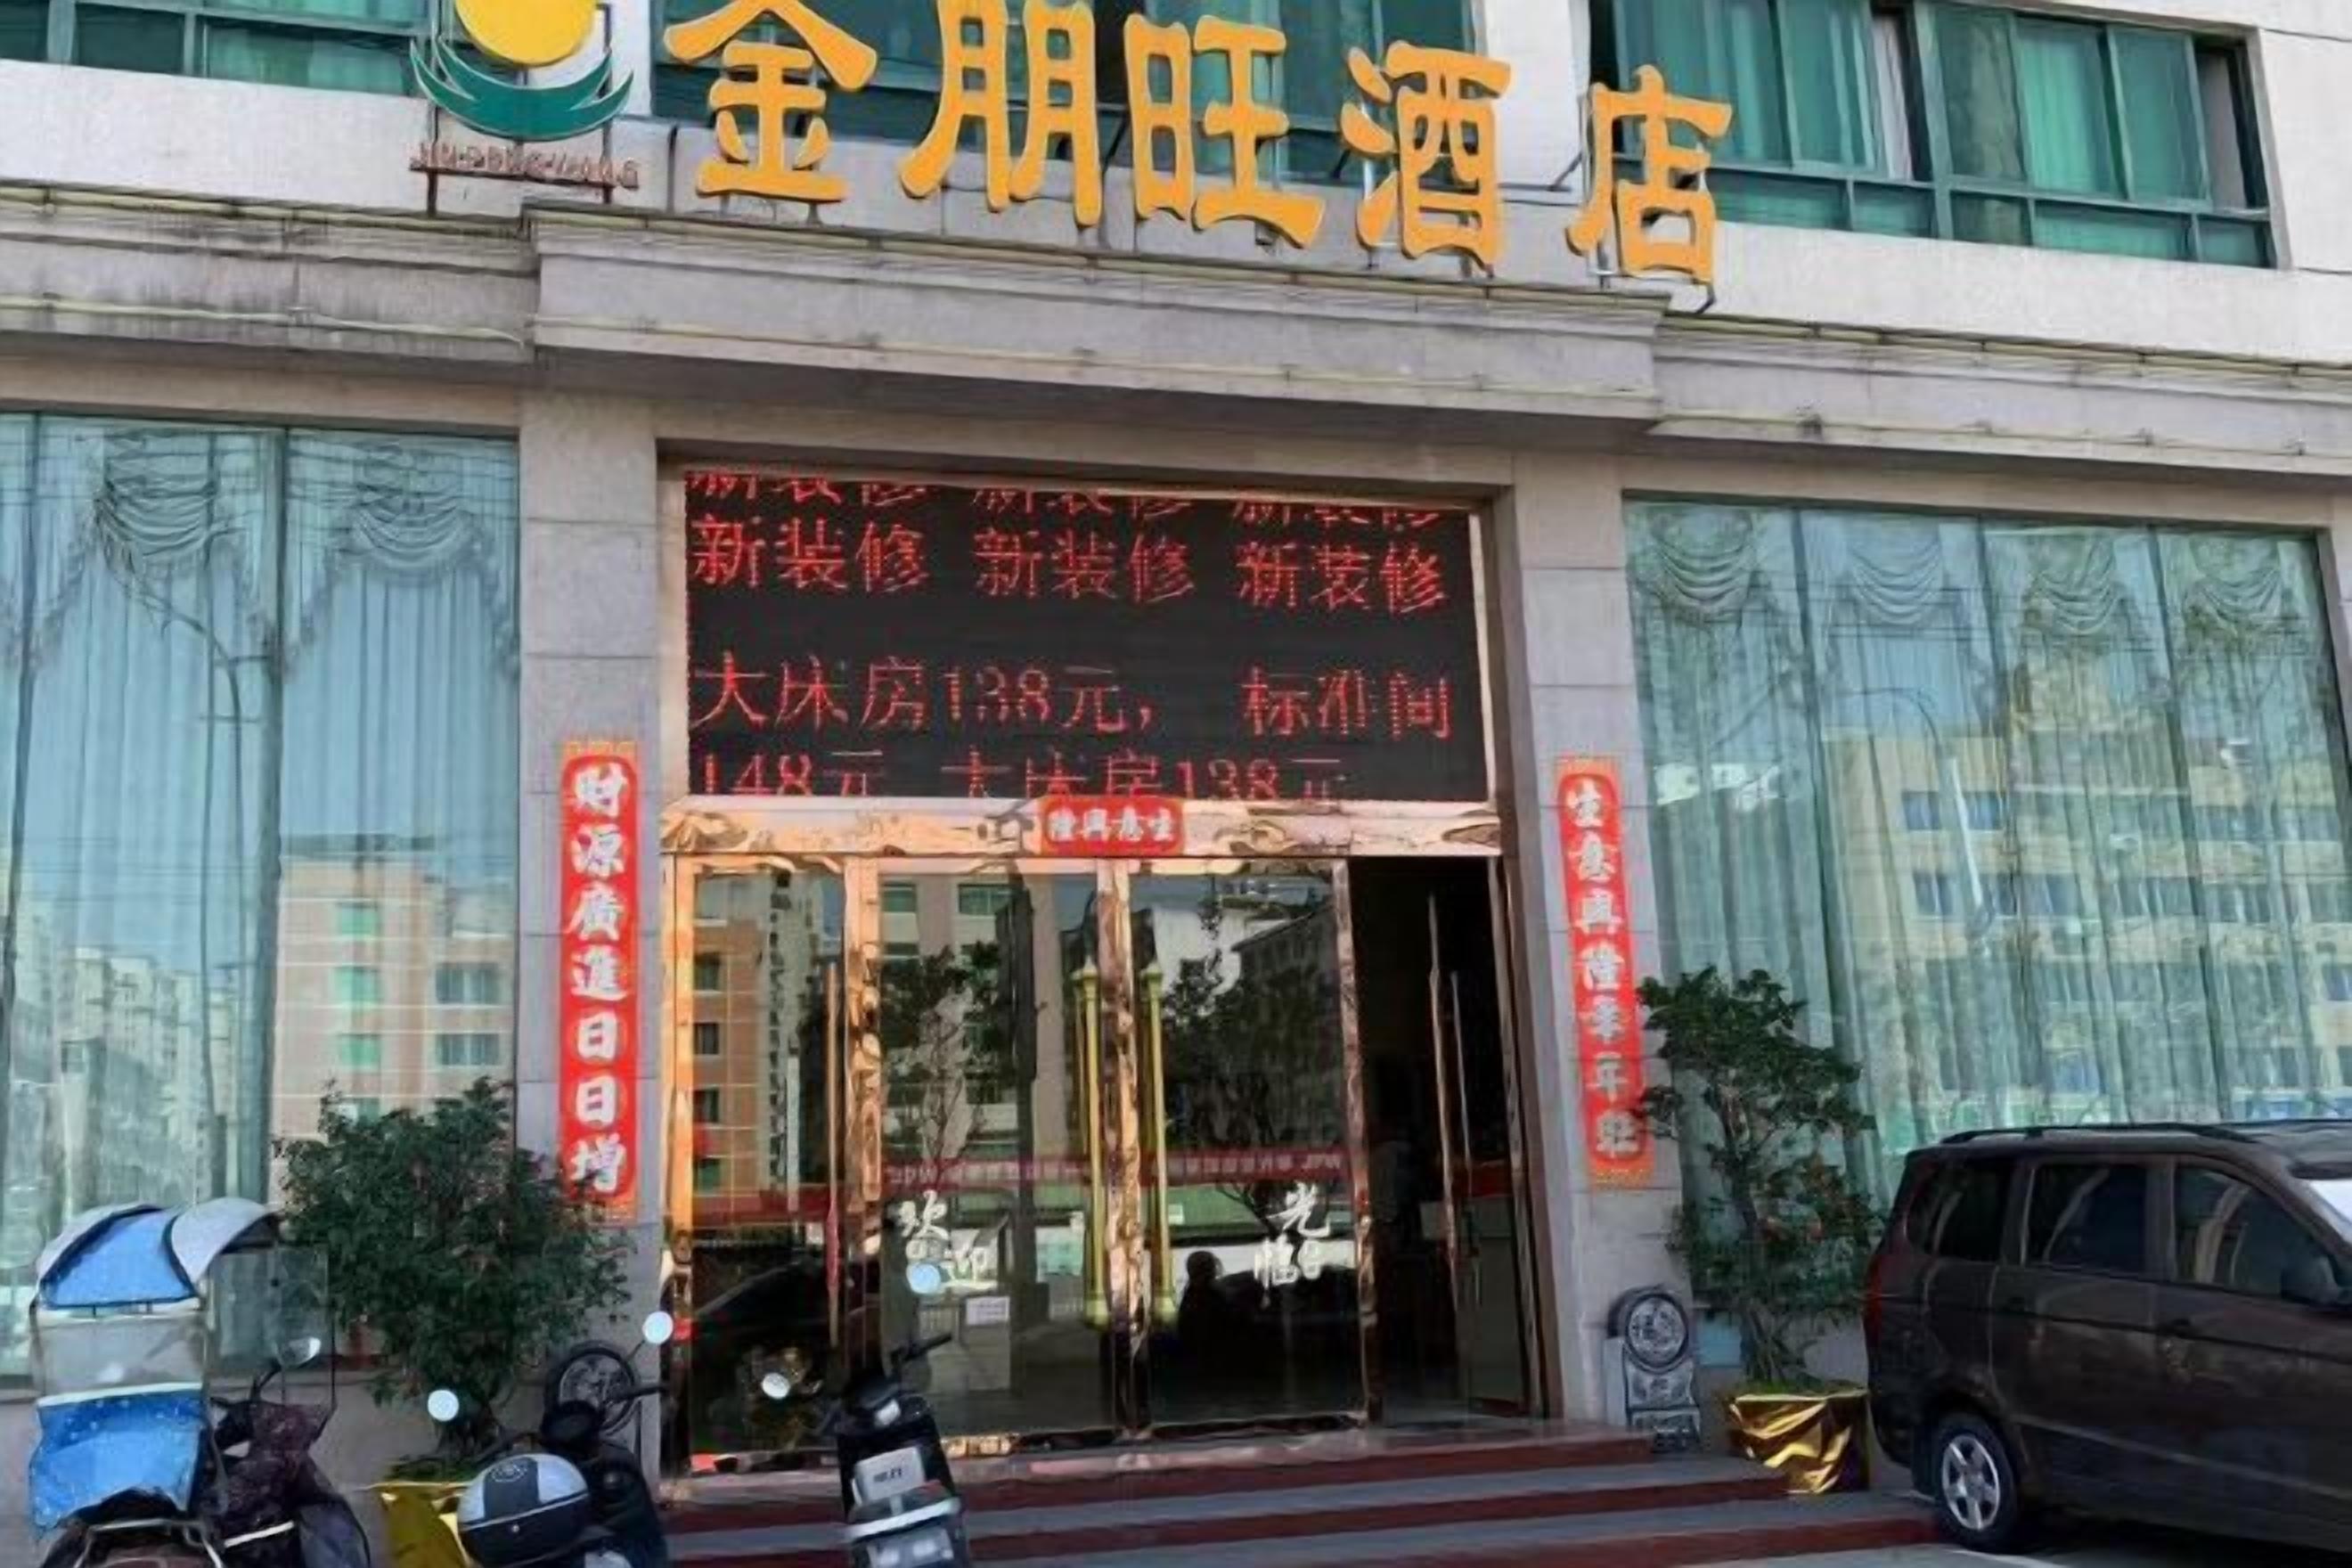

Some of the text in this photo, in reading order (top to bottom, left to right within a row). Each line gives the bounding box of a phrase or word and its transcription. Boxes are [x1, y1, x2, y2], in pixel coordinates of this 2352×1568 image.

[663, 0, 1732, 283] 金朋旺酒店
[691, 513, 1448, 615] 新装修 新装修 新装修
